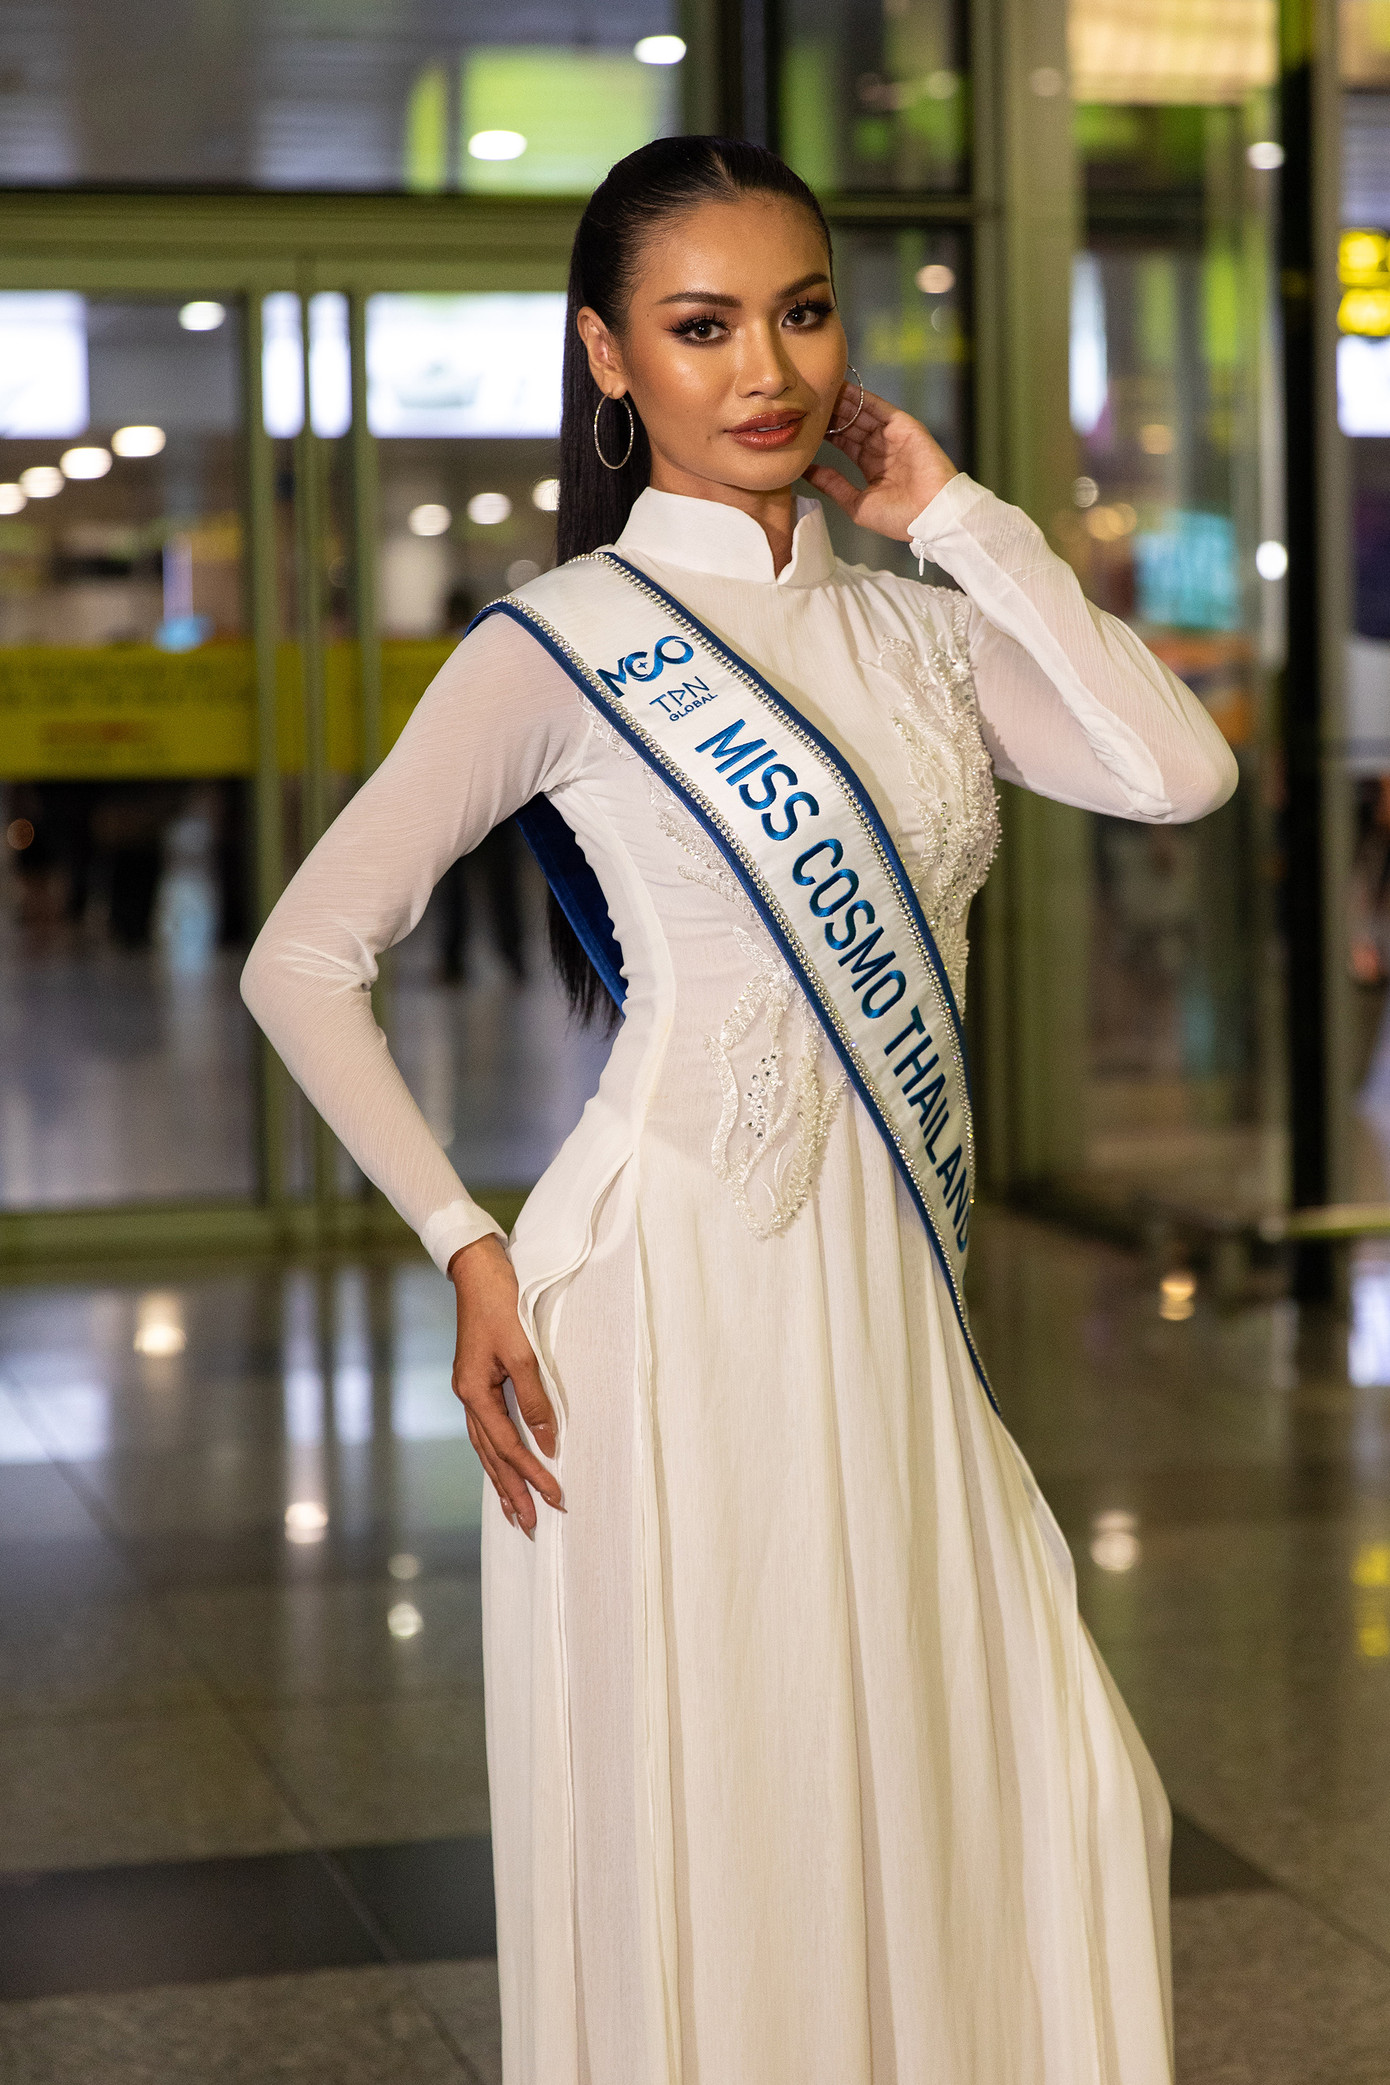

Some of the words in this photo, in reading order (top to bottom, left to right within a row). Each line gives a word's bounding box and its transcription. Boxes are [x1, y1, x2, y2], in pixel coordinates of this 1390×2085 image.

[669, 693, 718, 722] GLOBAL
[694, 718, 820, 841] MISS
[792, 838, 907, 1020] COSMO
